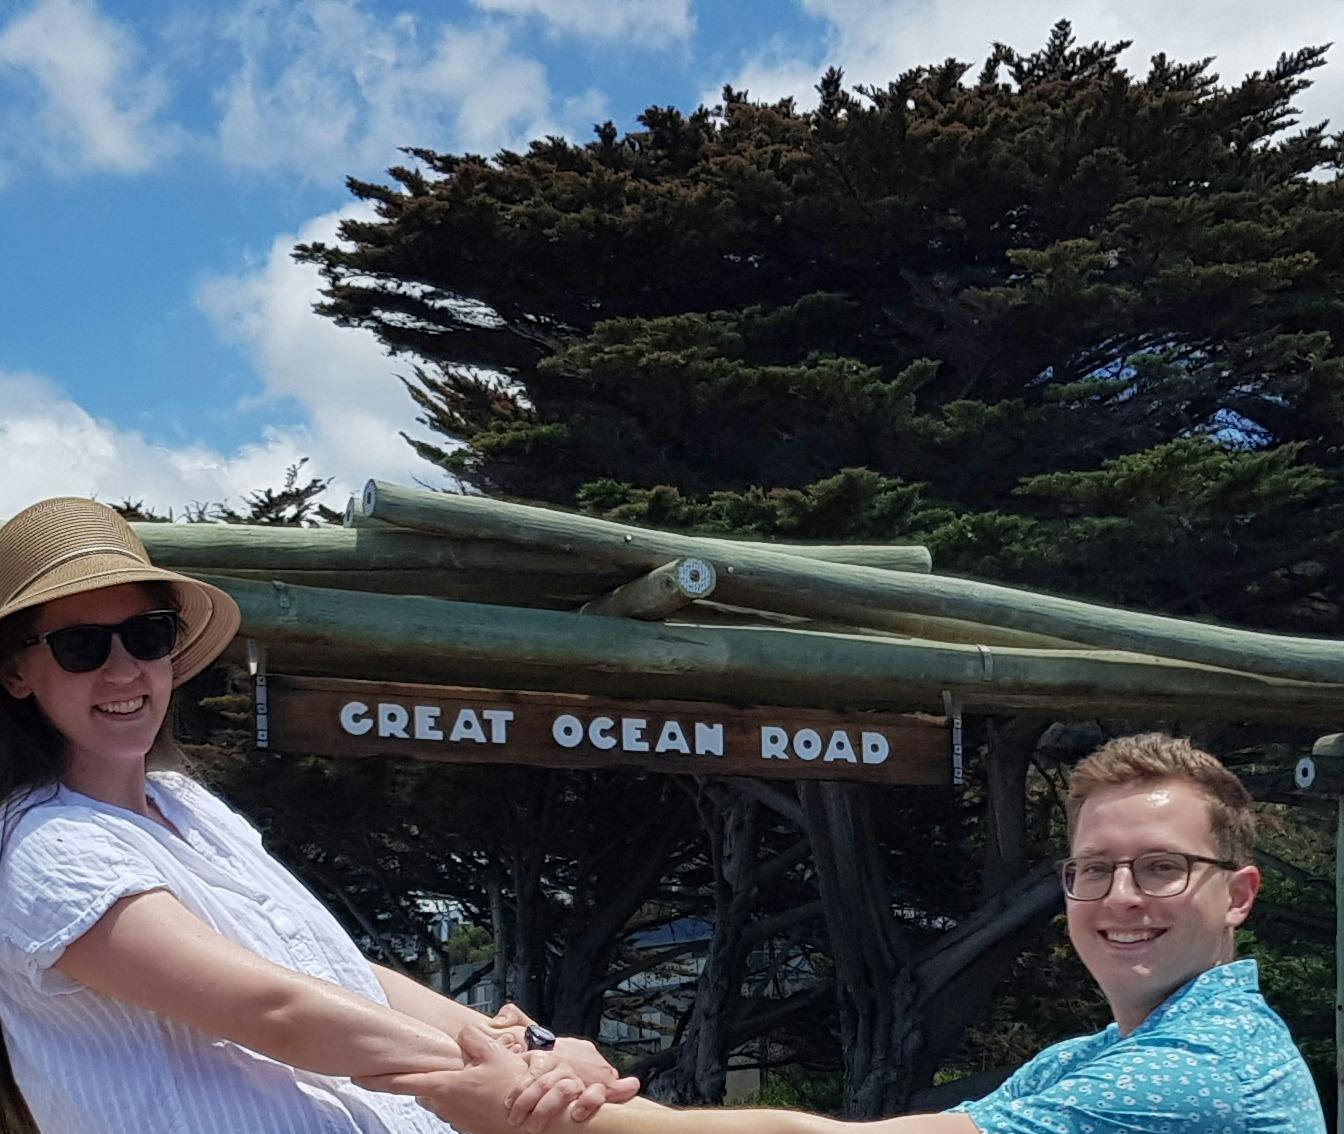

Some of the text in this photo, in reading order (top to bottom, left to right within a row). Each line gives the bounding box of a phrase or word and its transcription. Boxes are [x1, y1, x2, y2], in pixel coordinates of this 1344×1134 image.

[340, 701, 890, 765] GREAT OCEAN ROAD
